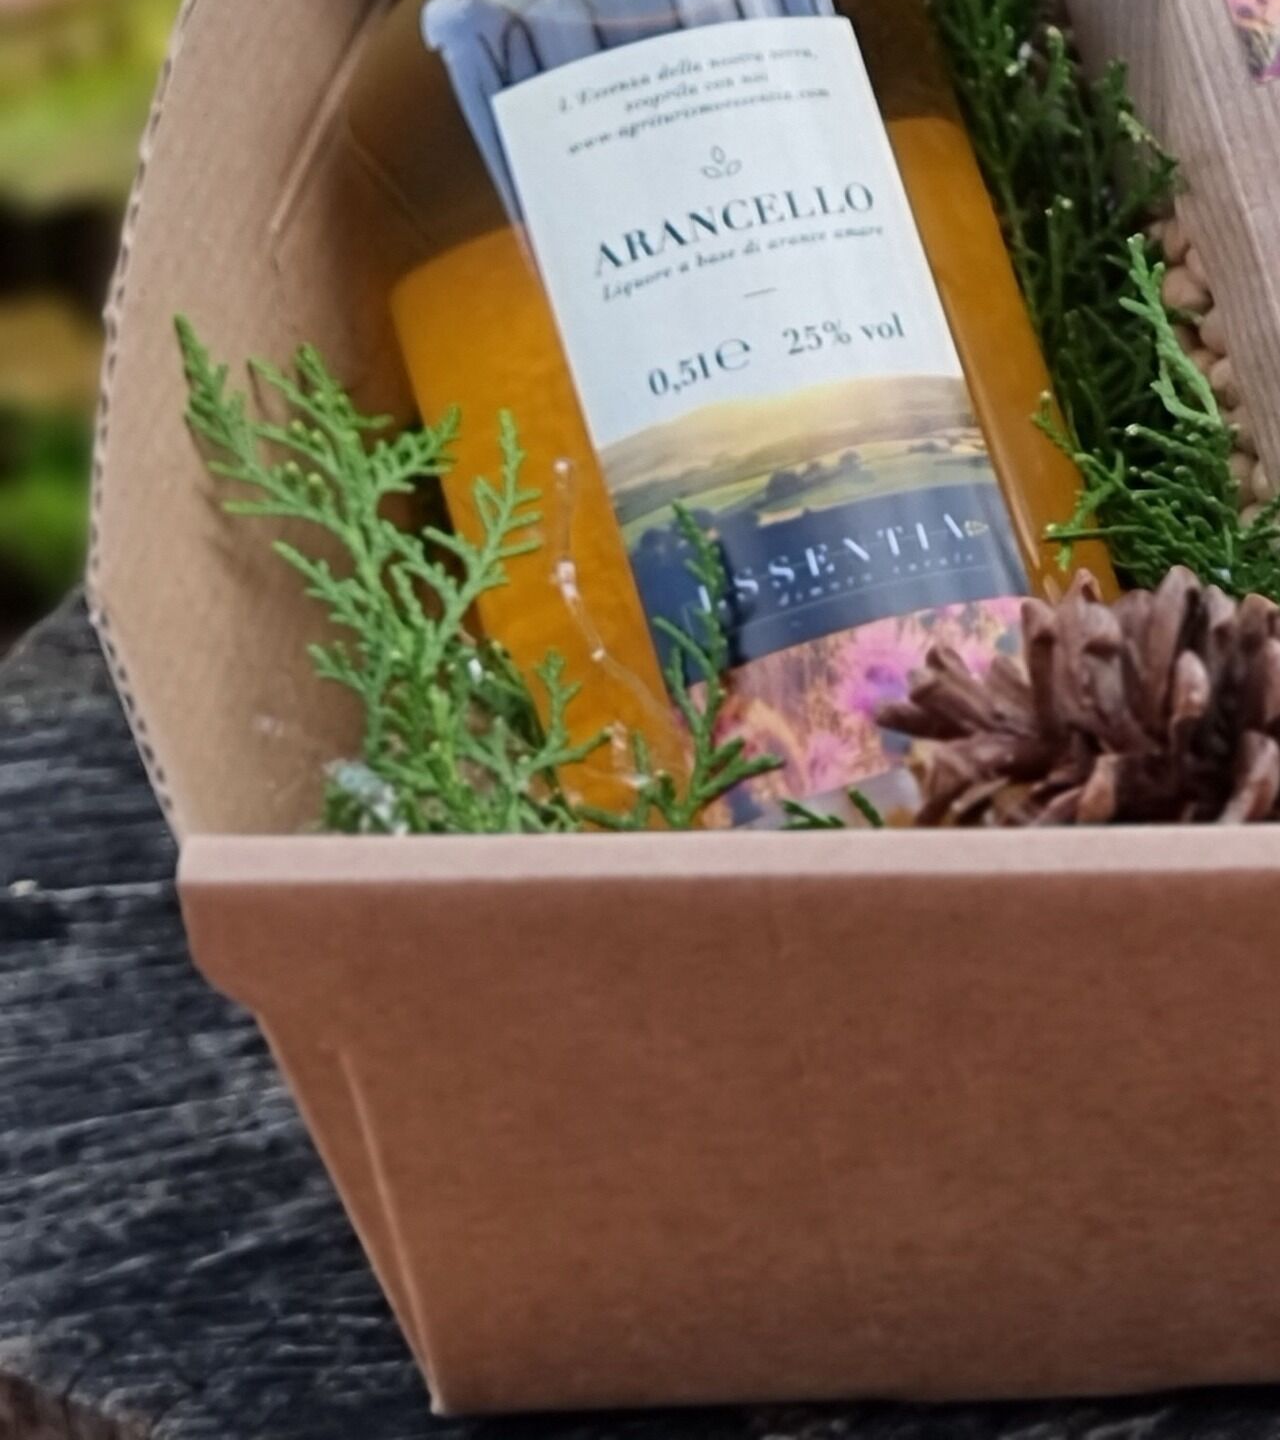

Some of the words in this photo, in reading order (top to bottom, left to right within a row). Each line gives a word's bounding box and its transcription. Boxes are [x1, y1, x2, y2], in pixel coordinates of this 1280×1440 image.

[594, 181, 875, 278] ARANCELLO
[602, 267, 672, 302] Liquore
[679, 261, 690, 273] a
[695, 248, 735, 268] base
[742, 239, 761, 255] di
[767, 230, 827, 250] arance
[833, 225, 884, 240] amare
[782, 318, 852, 357] 25%
[859, 312, 905, 343] vol
